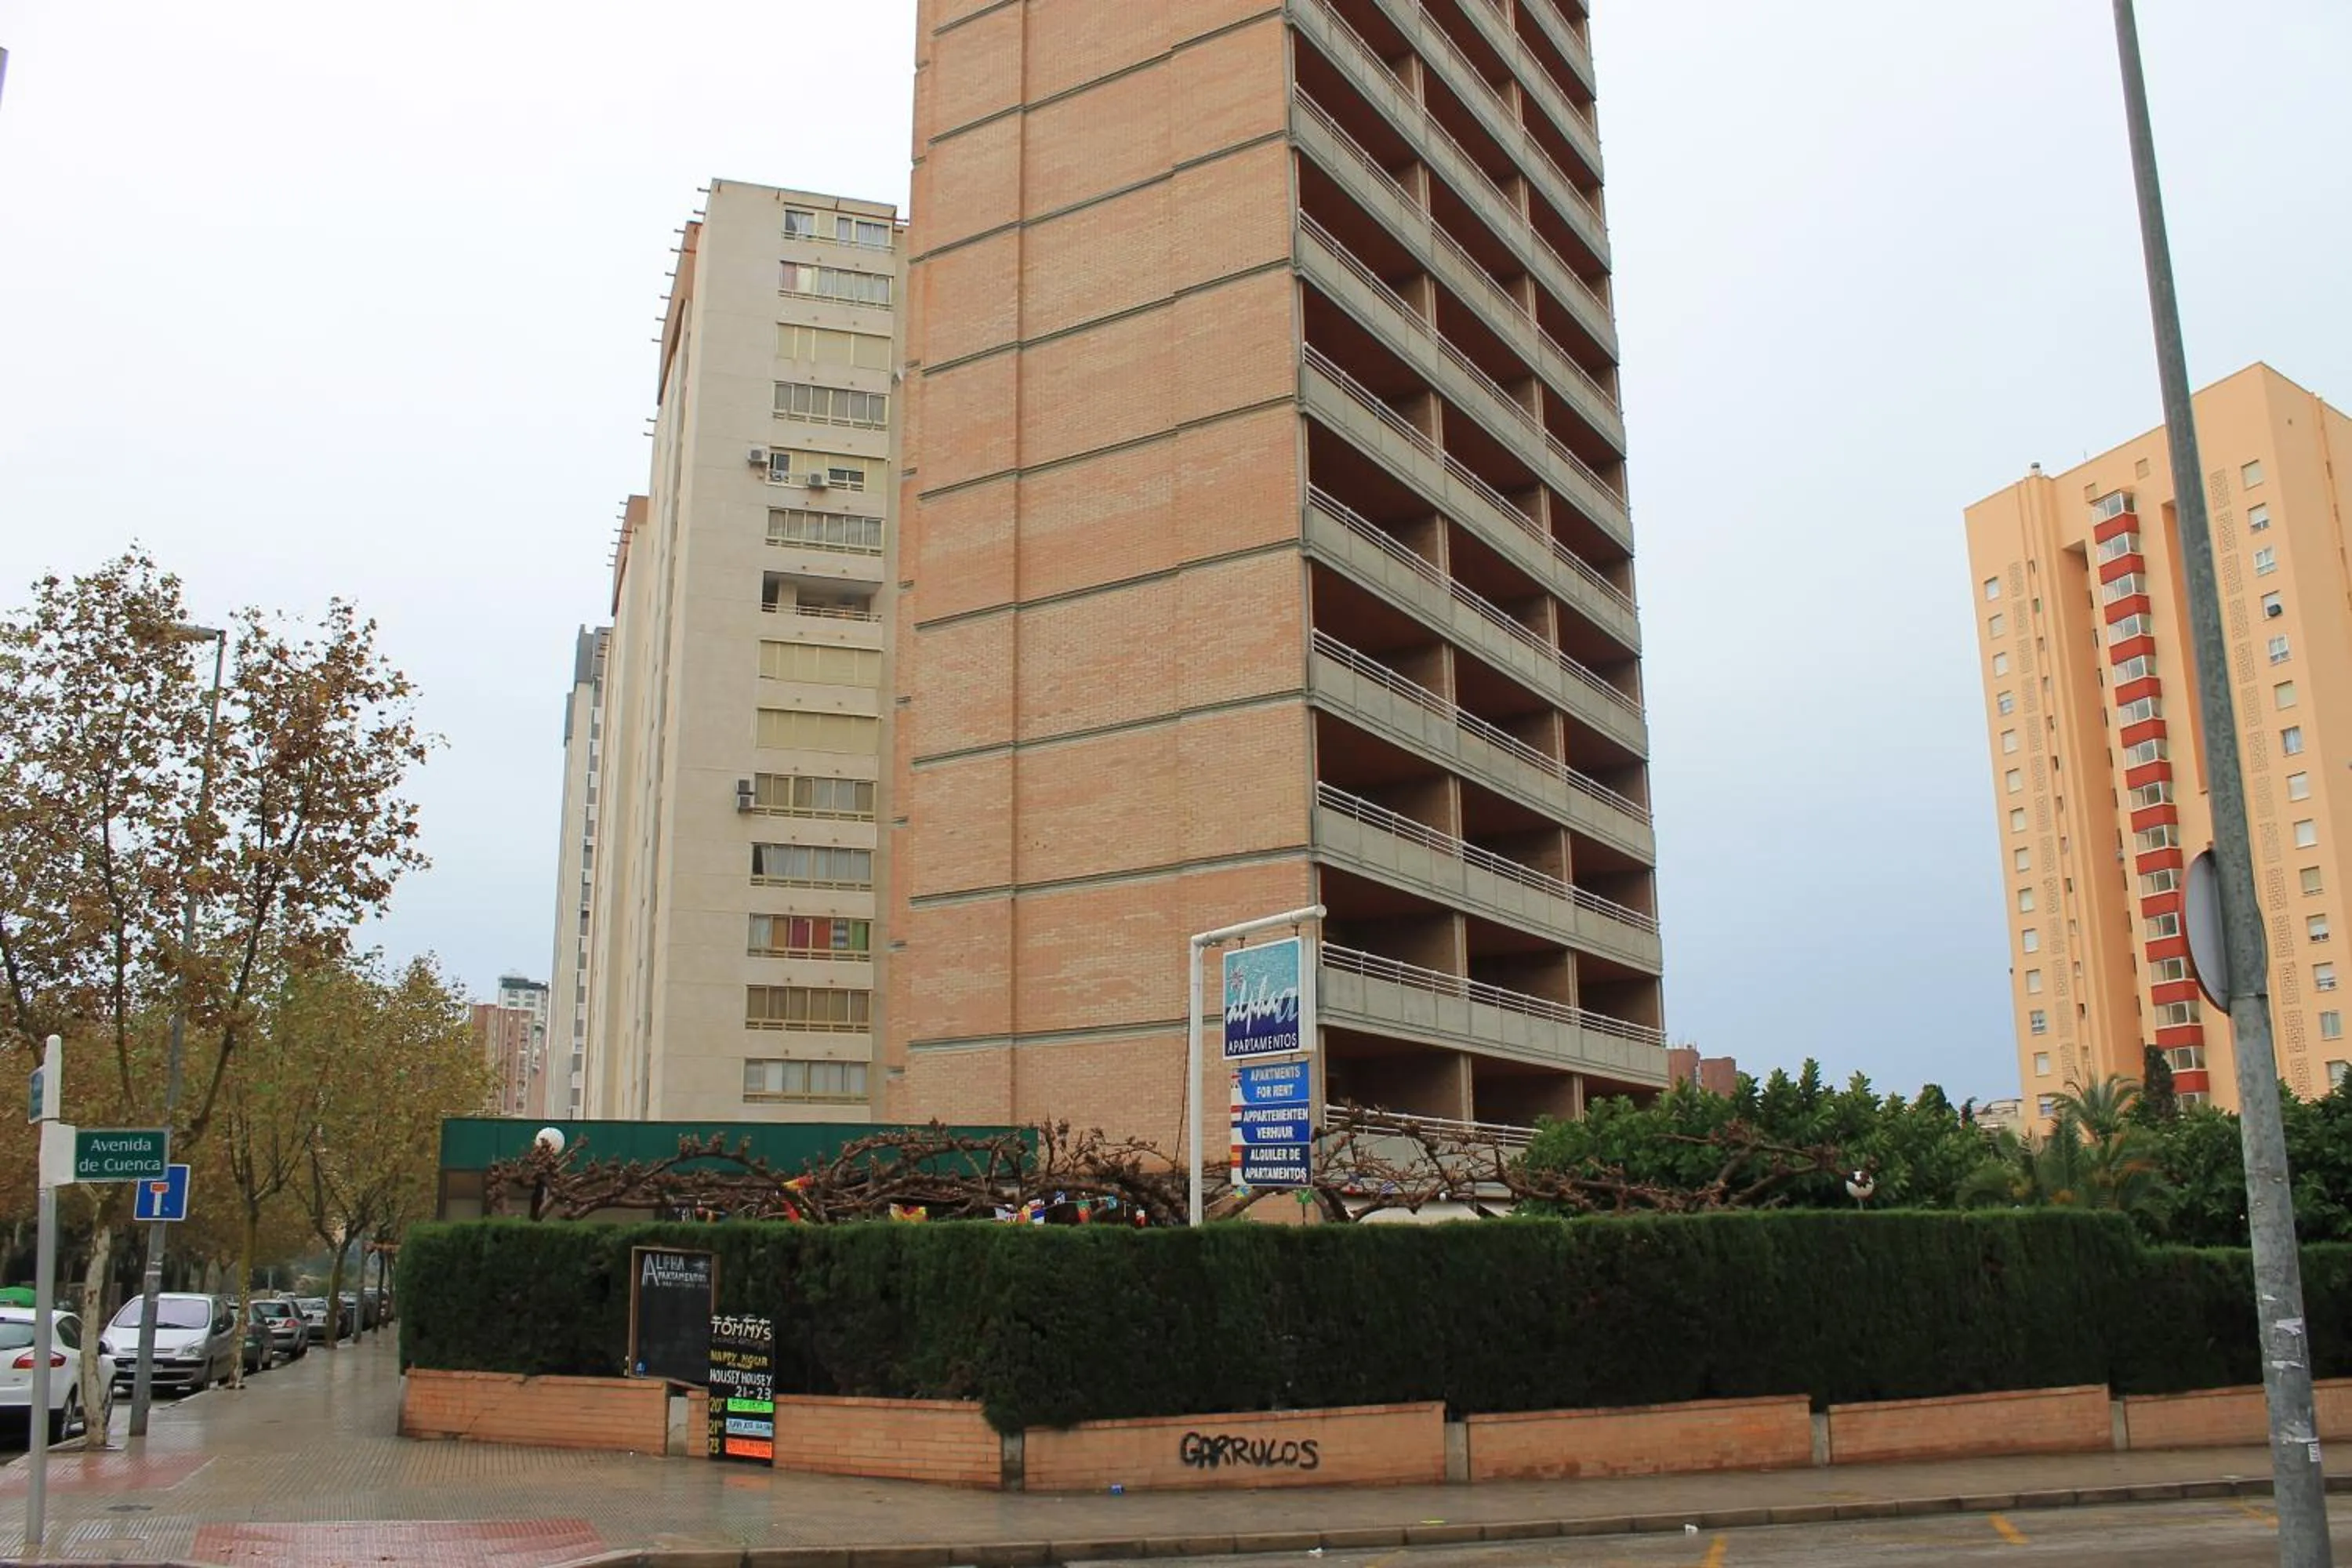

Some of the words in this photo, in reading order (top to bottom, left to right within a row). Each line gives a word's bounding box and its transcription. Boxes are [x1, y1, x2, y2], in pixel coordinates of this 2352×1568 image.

[1228, 1033, 1298, 1054] APARTAMENTOS
[1250, 1065, 1301, 1081] APARTMENTS
[1257, 1085, 1272, 1098] FOR
[1273, 1084, 1294, 1098] RENT
[1243, 1106, 1309, 1123] APPARTEMENTEN
[1255, 1125, 1294, 1140] VERHUUR
[91, 1138, 152, 1152] Avenida
[1250, 1147, 1287, 1162] ALQUILER
[1289, 1147, 1301, 1161] DE
[79, 1158, 100, 1172] de
[103, 1158, 162, 1171] Cuenca
[1245, 1167, 1307, 1183] APARTAMENTOS
[710, 1368, 740, 1385] HOUSEY
[741, 1371, 772, 1387] HOUSEY
[1180, 1432, 1318, 1469] GARRULOS
